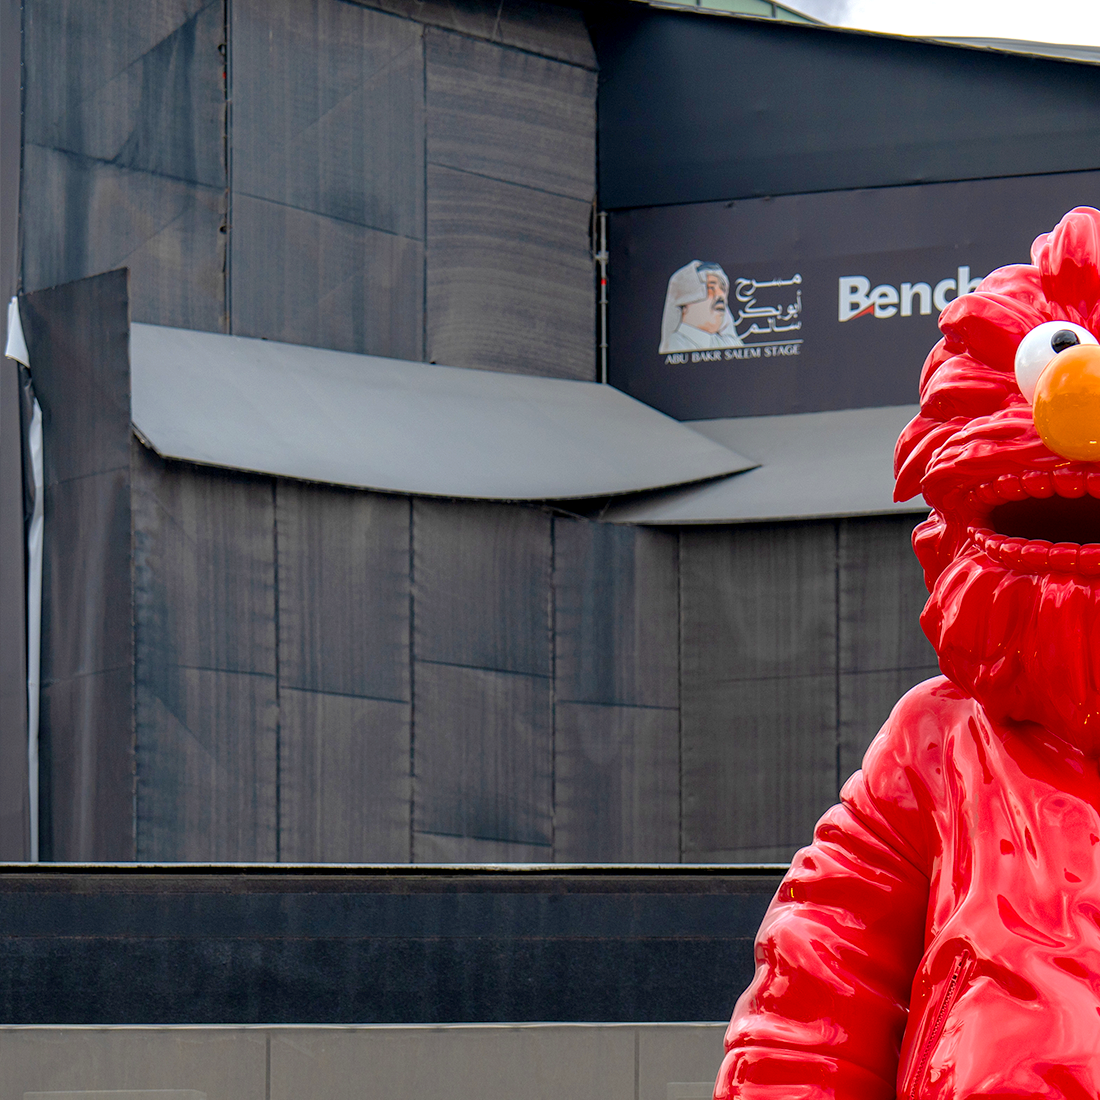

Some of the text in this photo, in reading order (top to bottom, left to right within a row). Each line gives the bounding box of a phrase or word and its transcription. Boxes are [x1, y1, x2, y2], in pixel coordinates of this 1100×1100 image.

[734, 272, 803, 303] مسرح
[738, 317, 802, 340] سالم
[664, 344, 801, 365] ABU BAKR SALEM STAGE
